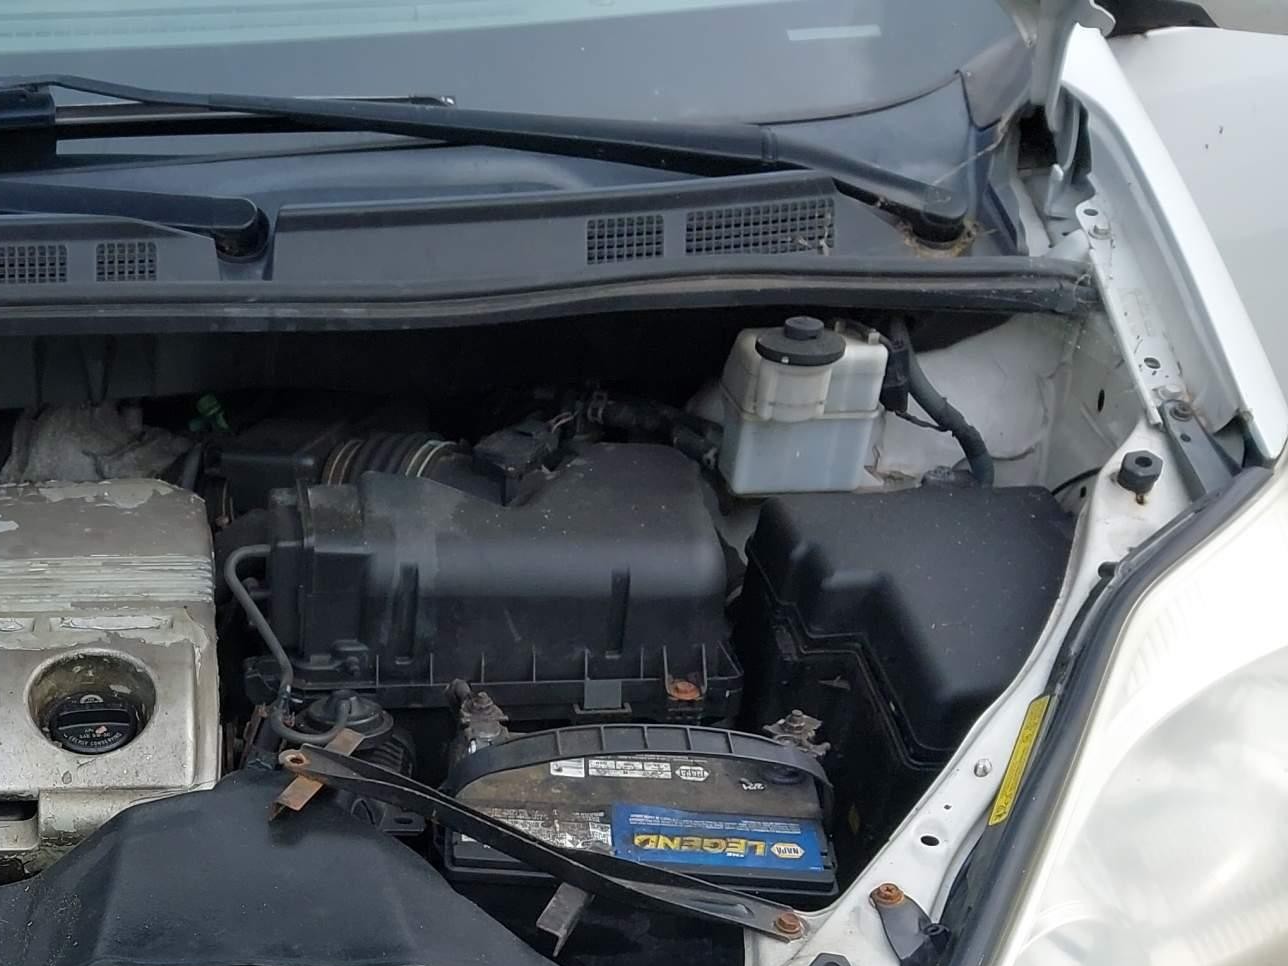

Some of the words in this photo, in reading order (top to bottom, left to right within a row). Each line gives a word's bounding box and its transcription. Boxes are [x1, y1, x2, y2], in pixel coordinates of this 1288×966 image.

[90, 731, 123, 746] CONSERVING
[634, 834, 767, 856] LEGEND
[775, 846, 799, 855] NAPA
